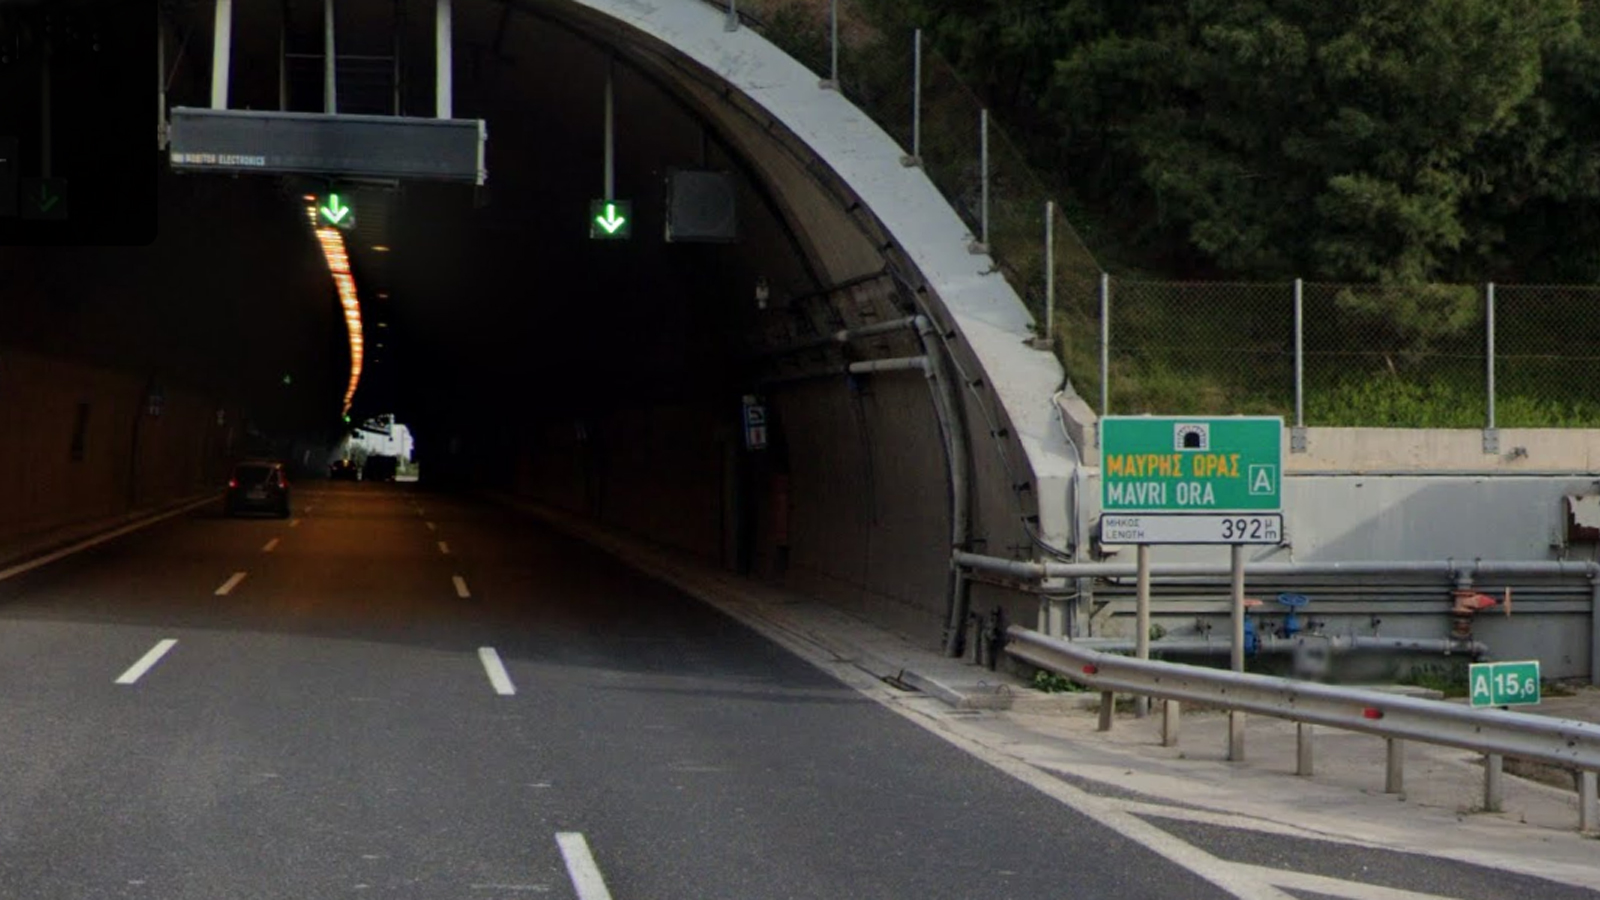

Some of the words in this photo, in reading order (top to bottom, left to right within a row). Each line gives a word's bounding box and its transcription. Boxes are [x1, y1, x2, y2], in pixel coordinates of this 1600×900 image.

[1107, 453, 1183, 477] ΜΑΥΡΗΣ
[1193, 453, 1240, 477] ΩΡΑΣ
[1108, 482, 1166, 505] MAVRI
[1176, 482, 1215, 505] ORA
[1106, 518, 1140, 528] ΜΗΚΟΣ
[1106, 529, 1145, 539] LENGTH
[1222, 518, 1262, 539] 392
[1494, 673, 1535, 699] 15,6
